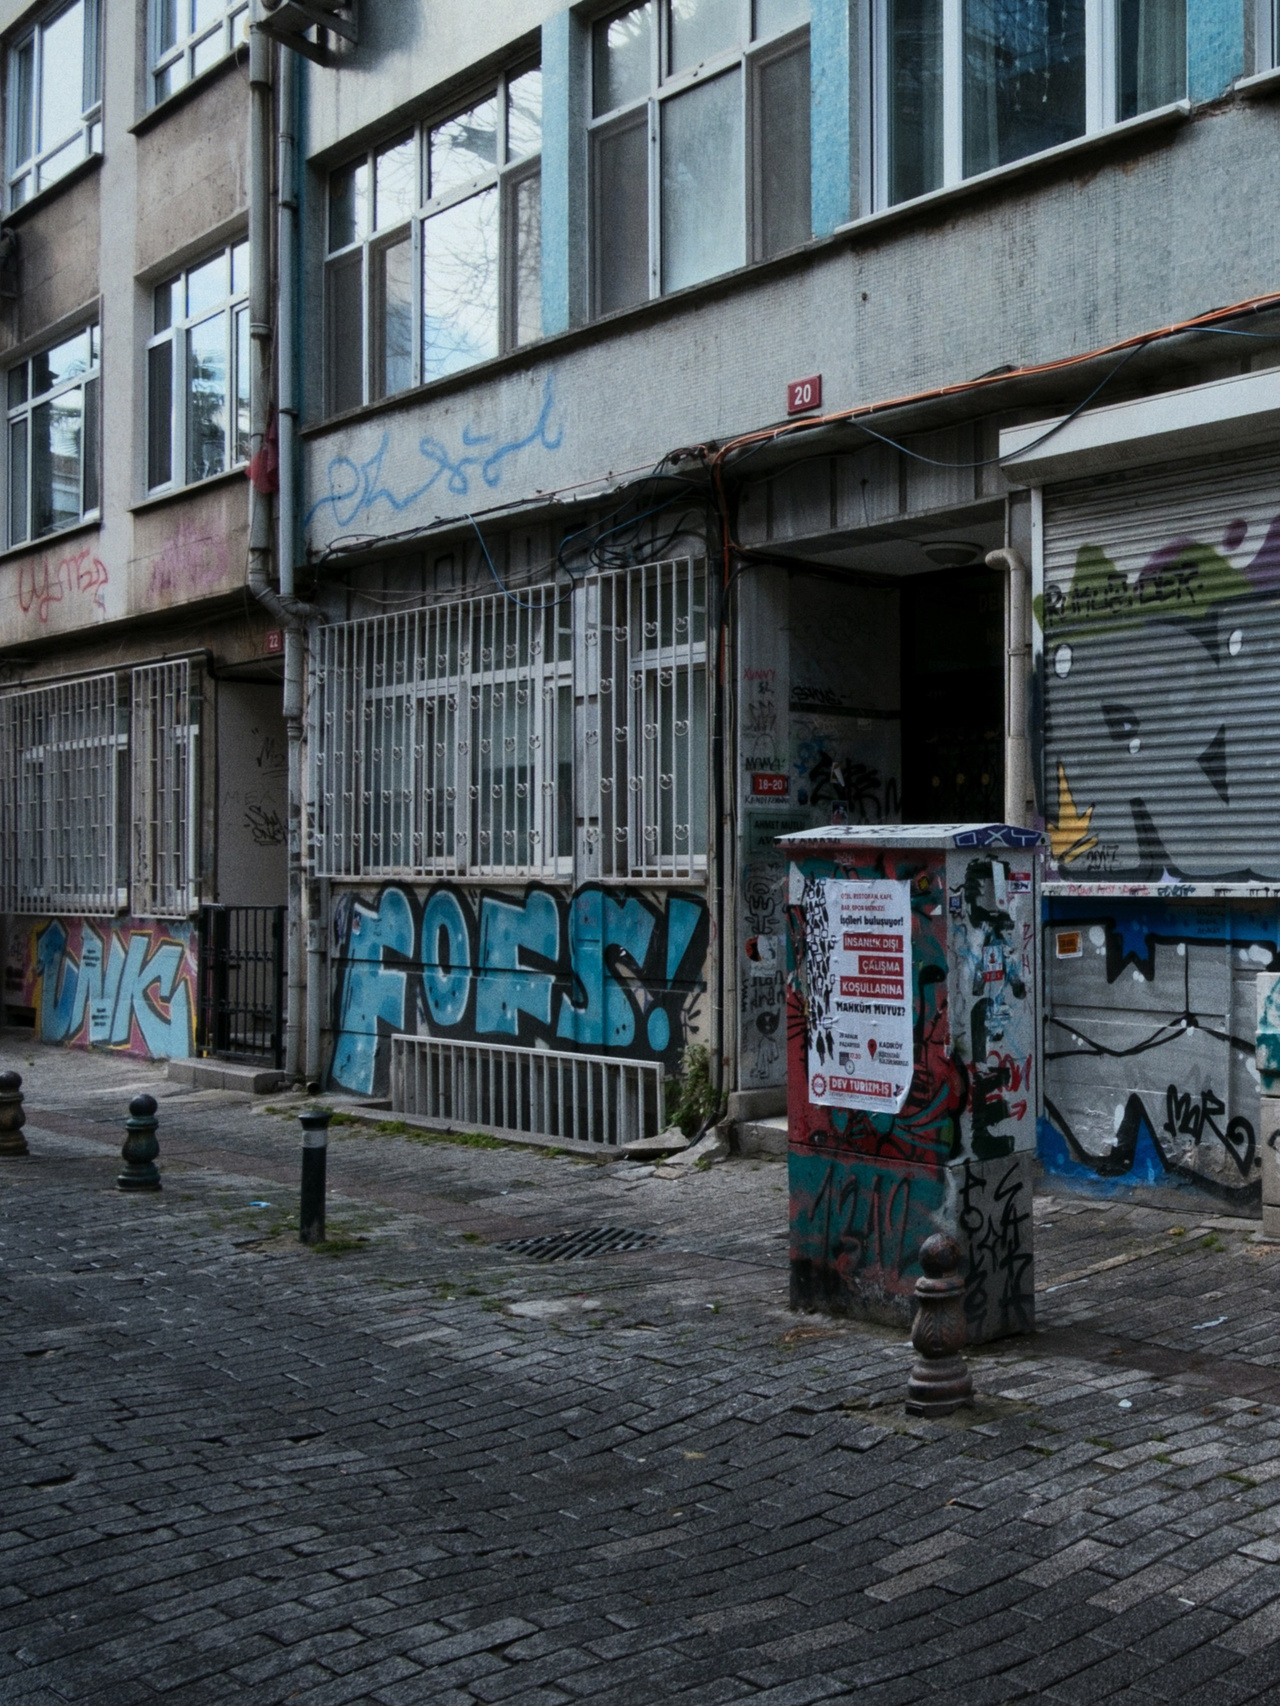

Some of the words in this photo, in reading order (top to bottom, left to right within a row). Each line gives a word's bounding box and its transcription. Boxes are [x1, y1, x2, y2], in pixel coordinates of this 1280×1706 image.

[794, 384, 812, 405] 20
[268, 634, 279, 649] 22
[758, 778, 783, 791] 18-20
[844, 935, 881, 947] İNSANLIK
[882, 940, 899, 952] DIŞI
[862, 960, 900, 974] ÇALIŞMA
[842, 982, 903, 996] KOŞULLARINA
[831, 1078, 847, 1089] DEV
[849, 1080, 889, 1097] TURİZM-İŞ
